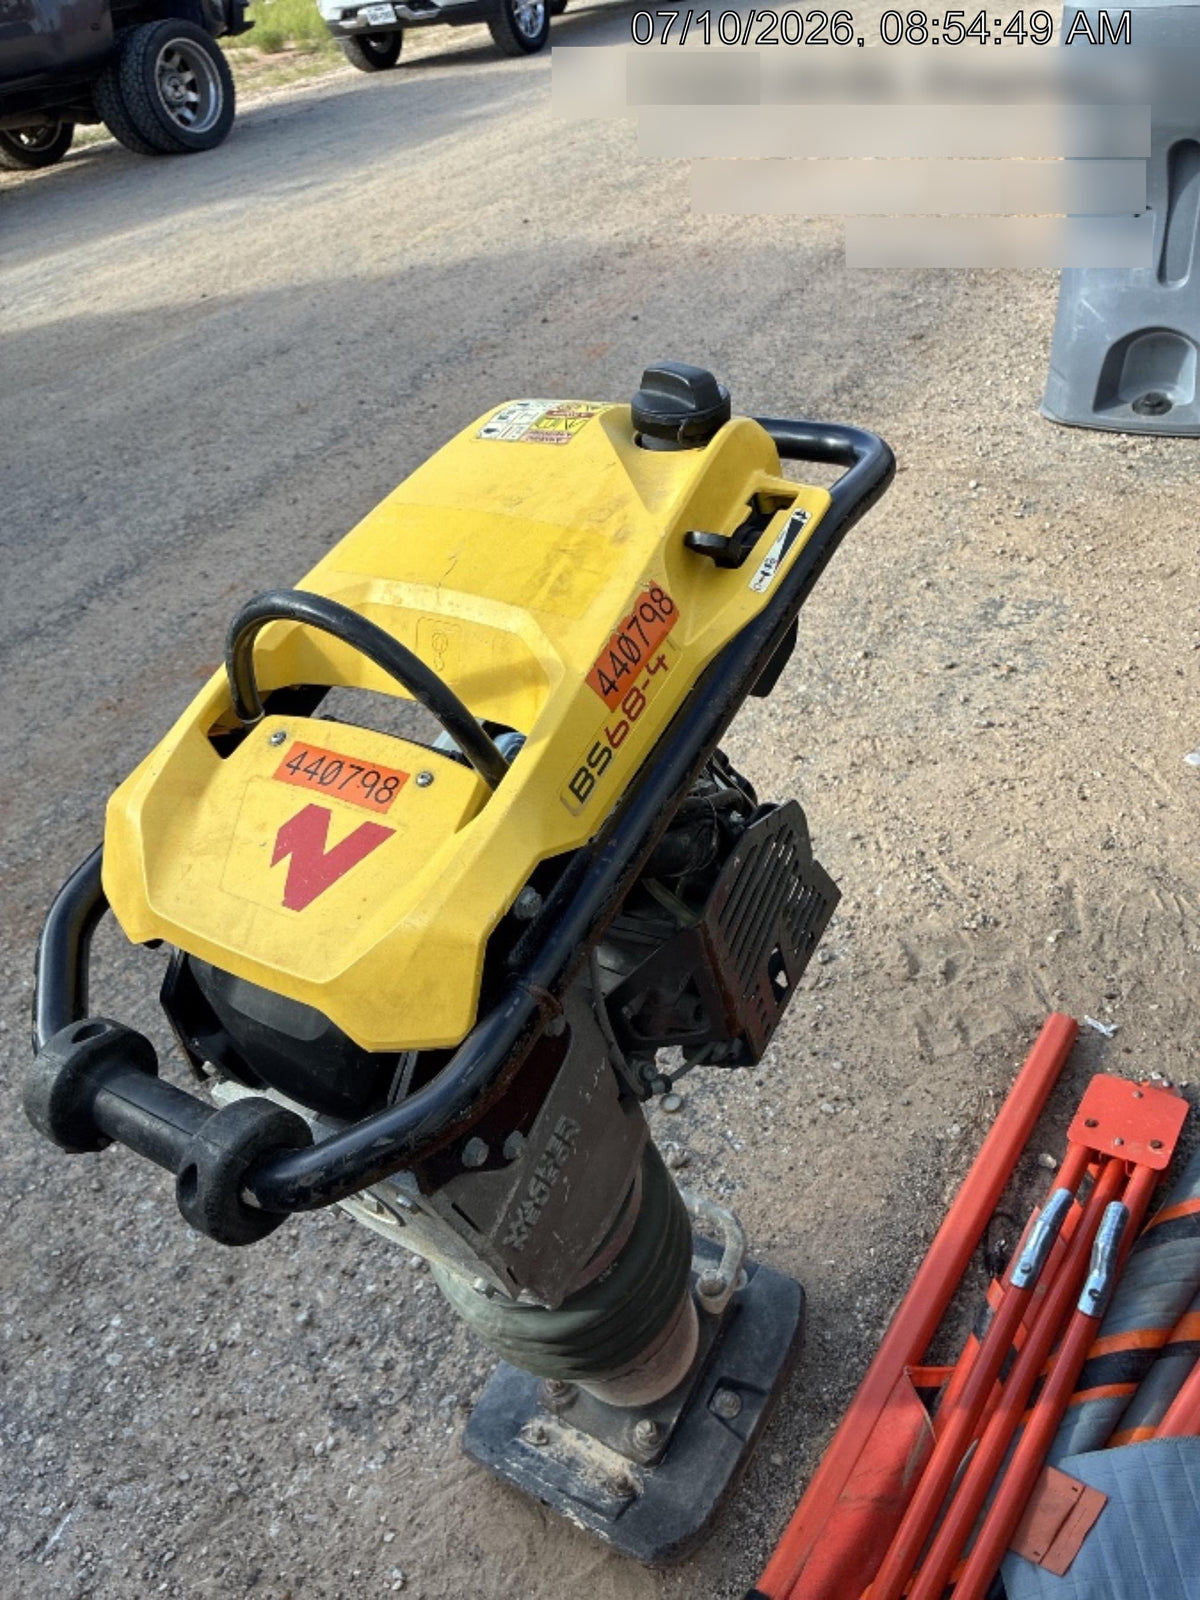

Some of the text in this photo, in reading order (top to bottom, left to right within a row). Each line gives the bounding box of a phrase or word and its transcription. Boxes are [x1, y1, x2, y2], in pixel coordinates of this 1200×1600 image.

[597, 587, 674, 696] 440798
[285, 751, 400, 804] 440798
[568, 654, 668, 804] BS68-4
